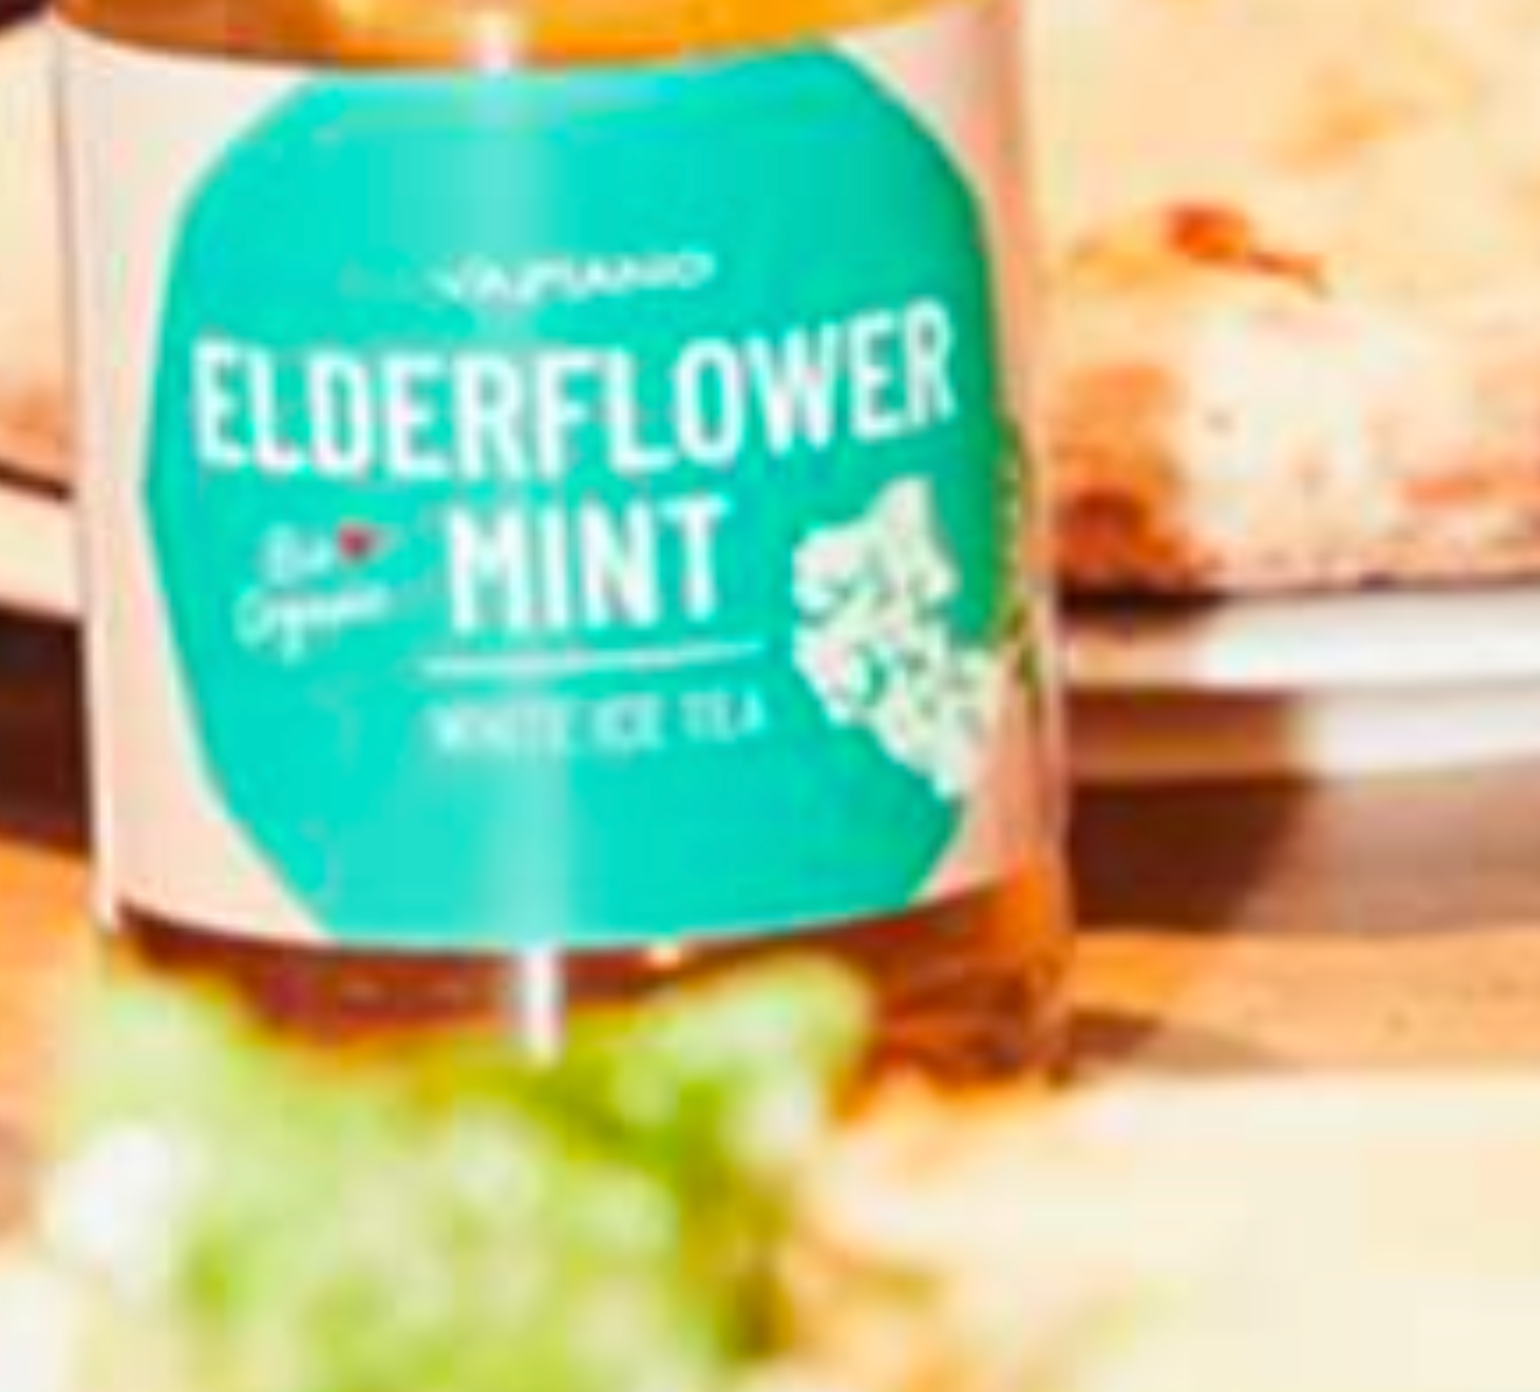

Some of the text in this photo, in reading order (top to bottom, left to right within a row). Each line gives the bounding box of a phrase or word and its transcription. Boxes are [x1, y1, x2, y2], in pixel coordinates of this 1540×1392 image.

[189, 295, 956, 483] ELDERFLOWER
[443, 491, 733, 637] MINT
[589, 692, 664, 748] ICE
[680, 685, 766, 741] TEA
